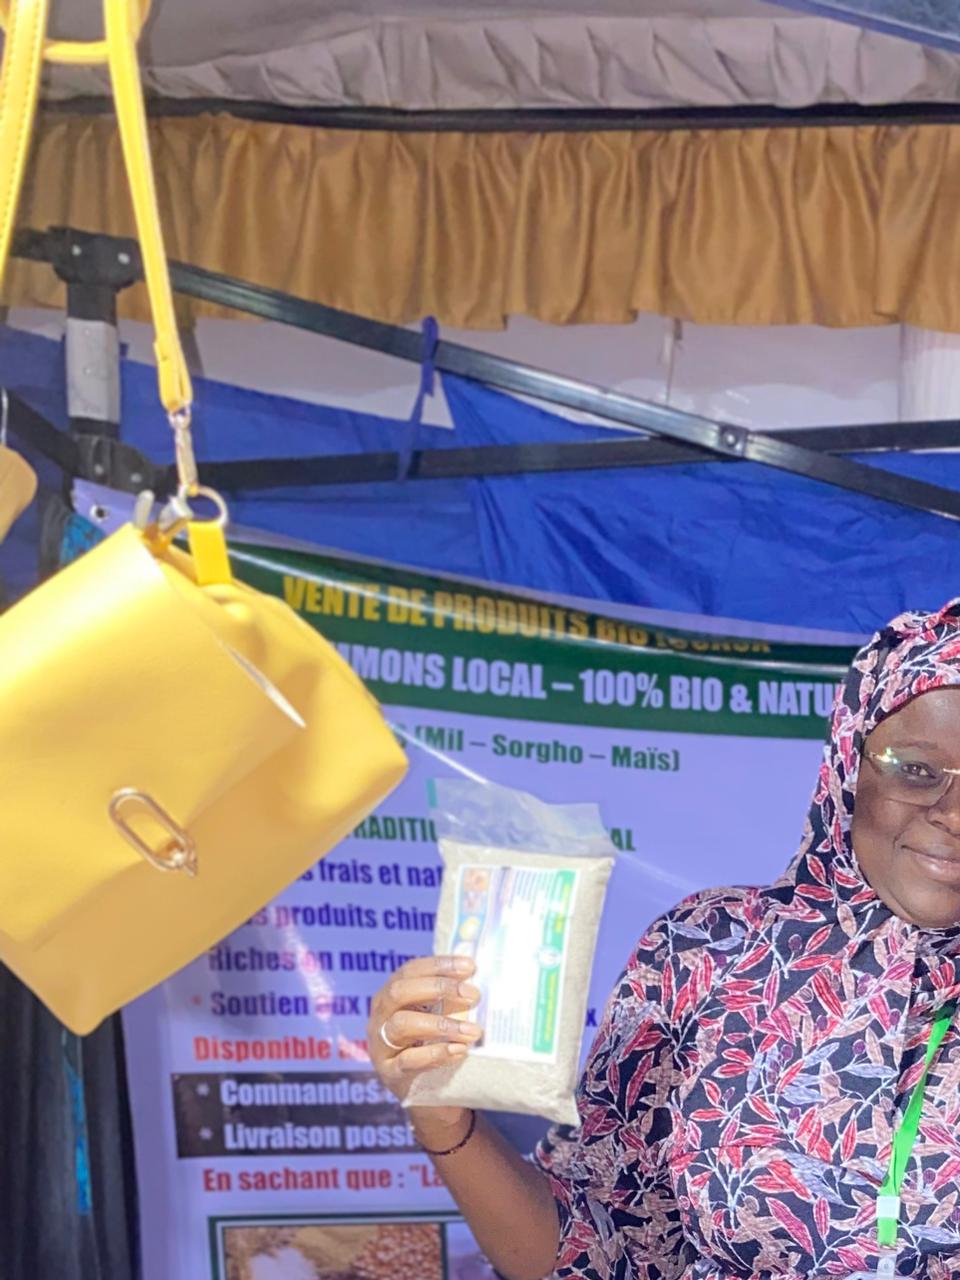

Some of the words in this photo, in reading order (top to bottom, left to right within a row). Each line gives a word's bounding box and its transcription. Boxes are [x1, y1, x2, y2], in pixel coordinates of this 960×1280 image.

[283, 576, 381, 621] VENTE
[387, 584, 427, 626] DE
[433, 590, 589, 641] PRODUITS
[452, 656, 547, 699] LOCAL
[579, 669, 664, 709] 100%
[669, 675, 724, 713] BIO
[729, 684, 753, 714] &
[758, 680, 834, 718] NATU
[493, 734, 583, 766] Sorgho
[611, 743, 681, 772] Maïs)
[318, 857, 372, 884] frais
[379, 863, 402, 886] et
[407, 863, 442, 888] nat
[275, 902, 377, 930] produits
[383, 906, 435, 932] chim
[209, 945, 295, 972] Riches
[210, 992, 309, 1016] Soutien
[315, 996, 360, 1017] aux
[193, 1035, 331, 1063] Disponible
[220, 1078, 379, 1107] Commandes
[223, 1122, 341, 1150] Livraison
[345, 1123, 415, 1150] possi
[203, 1168, 231, 1192] En
[239, 1166, 339, 1192] sachant
[345, 1168, 392, 1192] que
